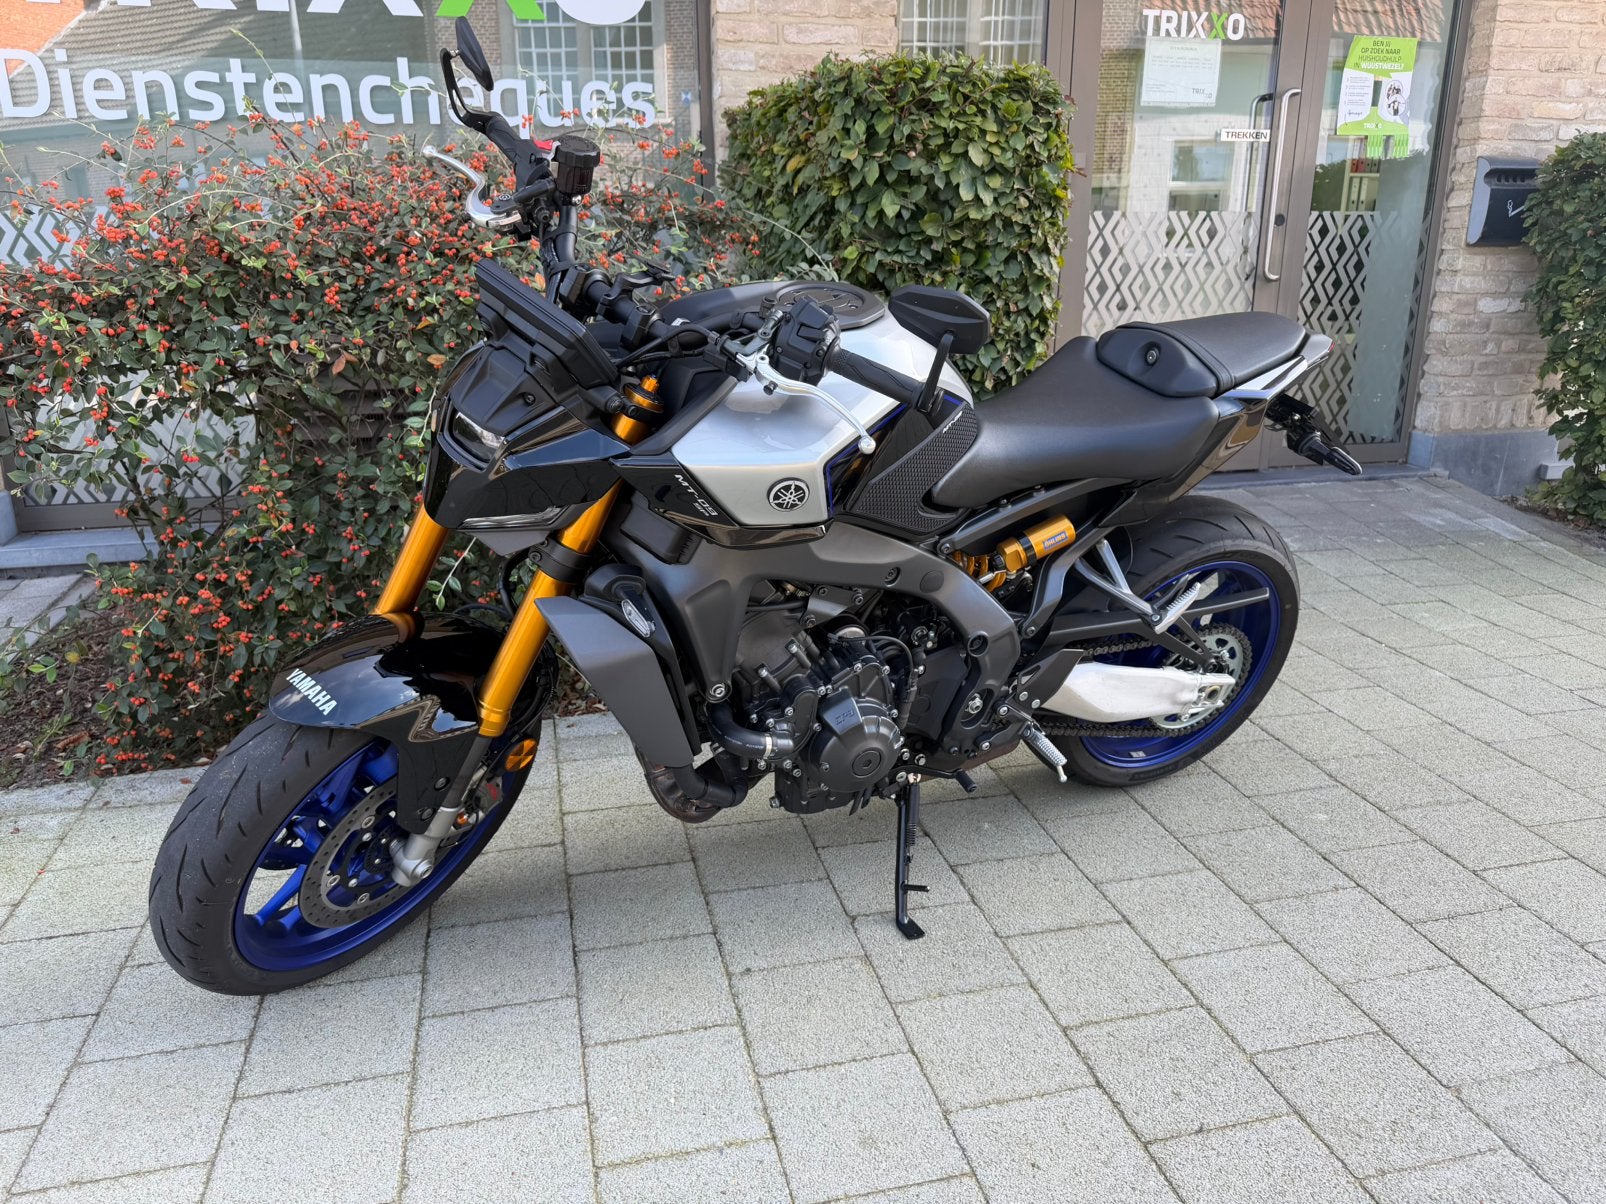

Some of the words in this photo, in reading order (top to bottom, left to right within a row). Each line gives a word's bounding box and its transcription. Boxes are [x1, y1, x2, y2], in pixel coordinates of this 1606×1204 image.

[1143, 9, 1245, 40] TRIXXO
[0, 48, 655, 139] Dienstencheques
[1225, 131, 1268, 140] TREKKEN
[674, 474, 719, 516] MT-09
[285, 668, 338, 716] YAMAHA
